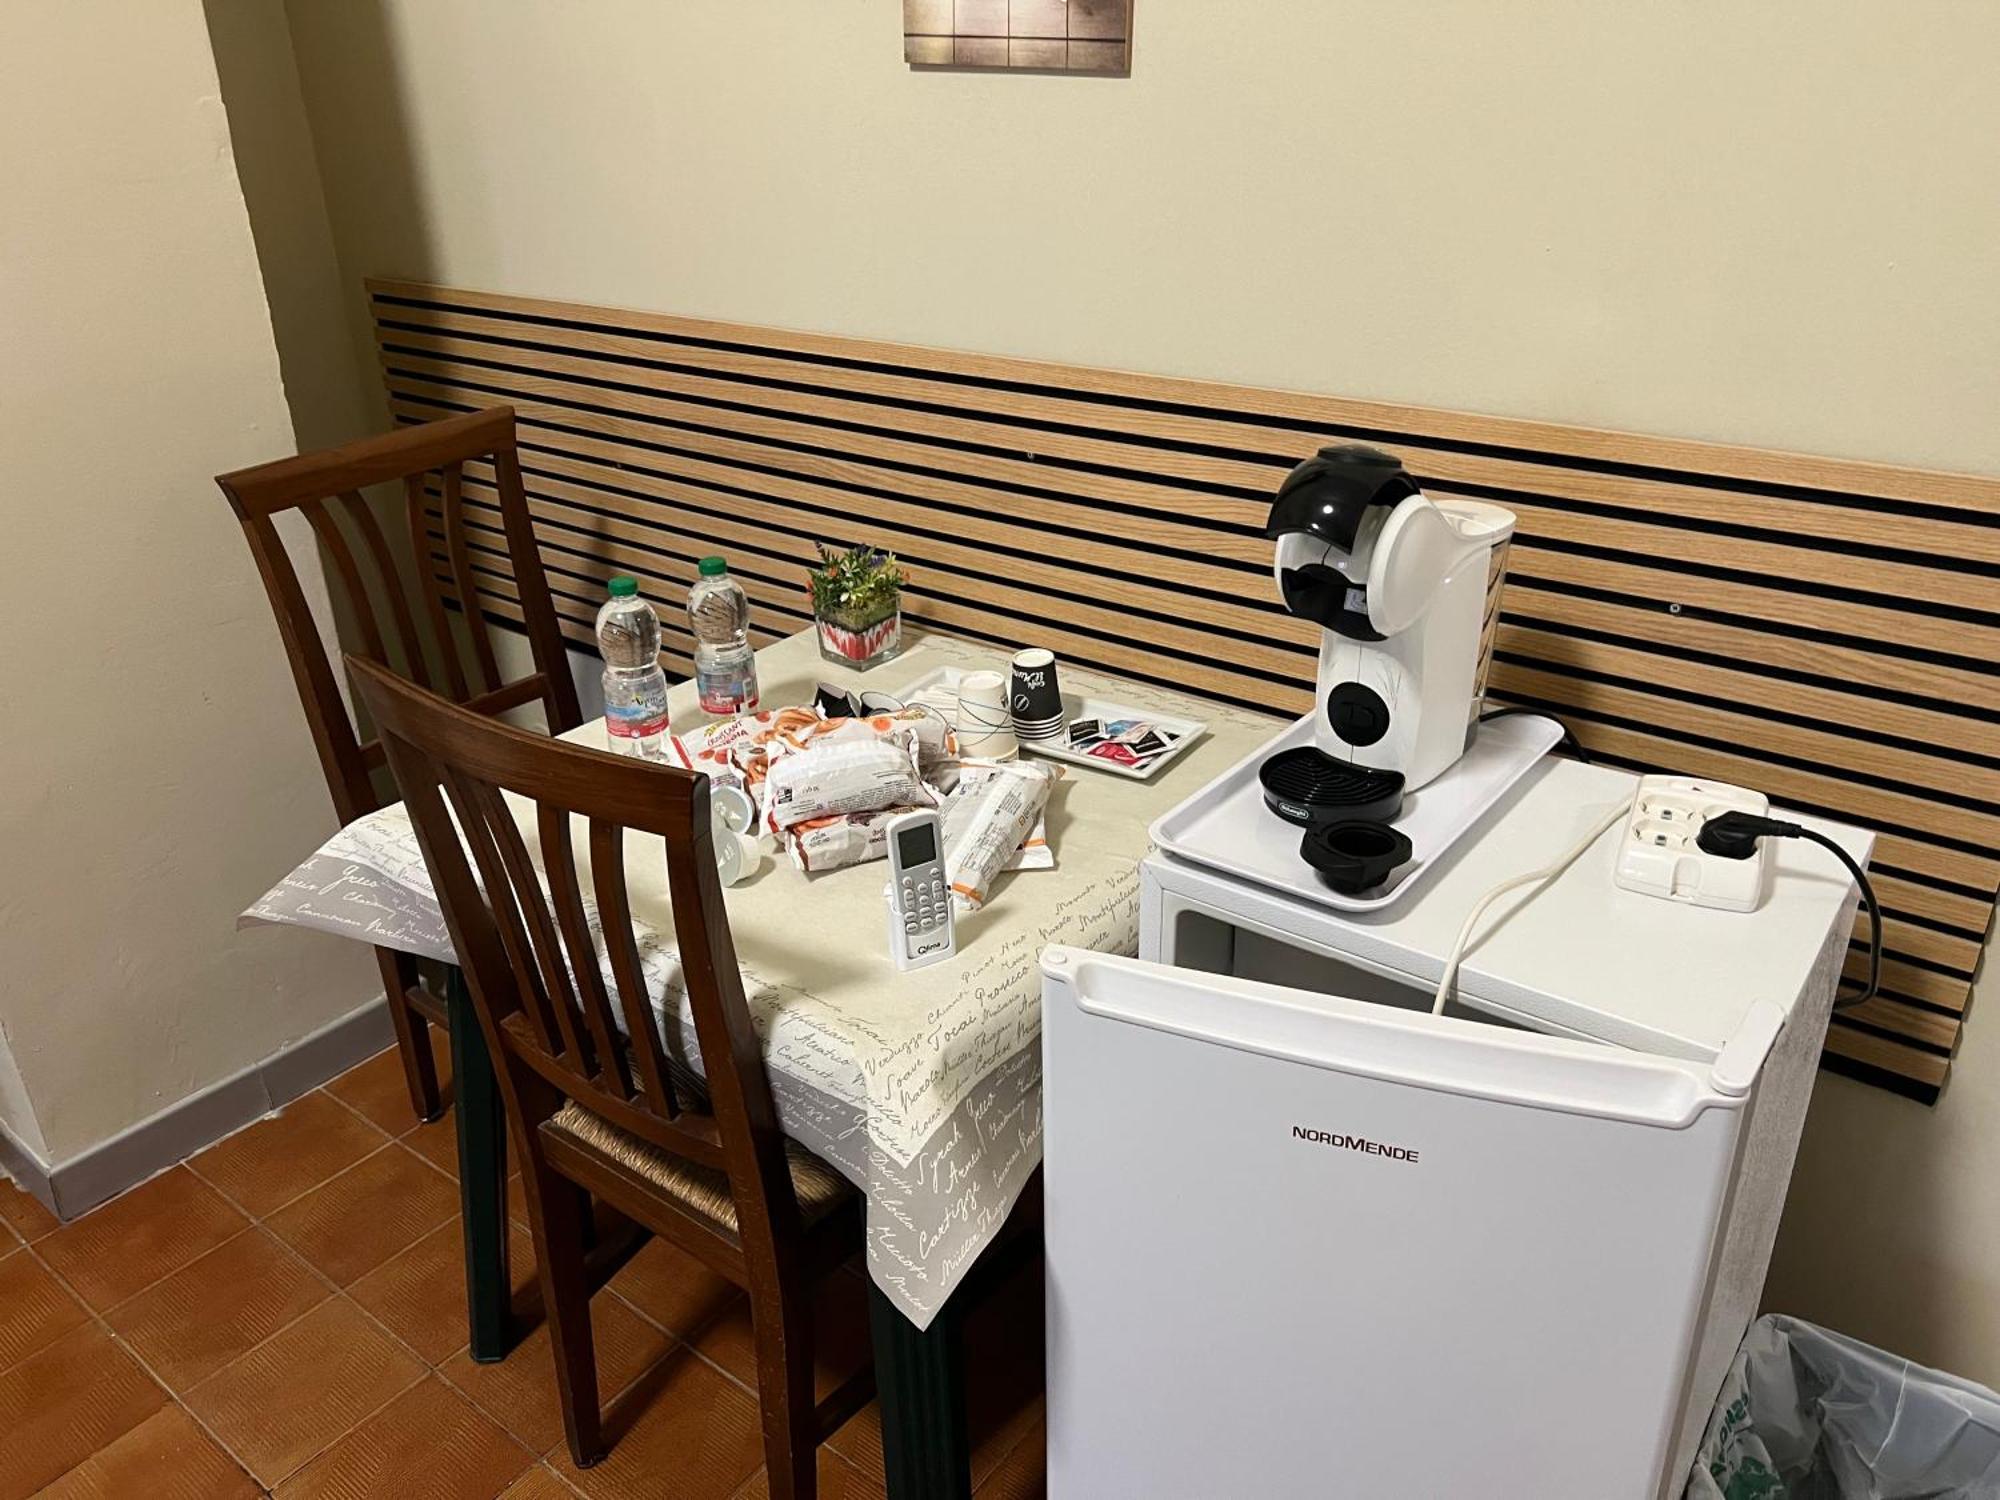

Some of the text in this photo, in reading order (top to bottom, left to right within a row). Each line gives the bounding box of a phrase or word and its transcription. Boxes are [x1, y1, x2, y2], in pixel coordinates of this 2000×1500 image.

[927, 1010, 978, 1052] Tocai
[864, 1032, 925, 1076] Verduzzo
[884, 1057, 925, 1101] Soave
[916, 1120, 964, 1194] Syrah
[918, 1180, 981, 1260] Cartizze
